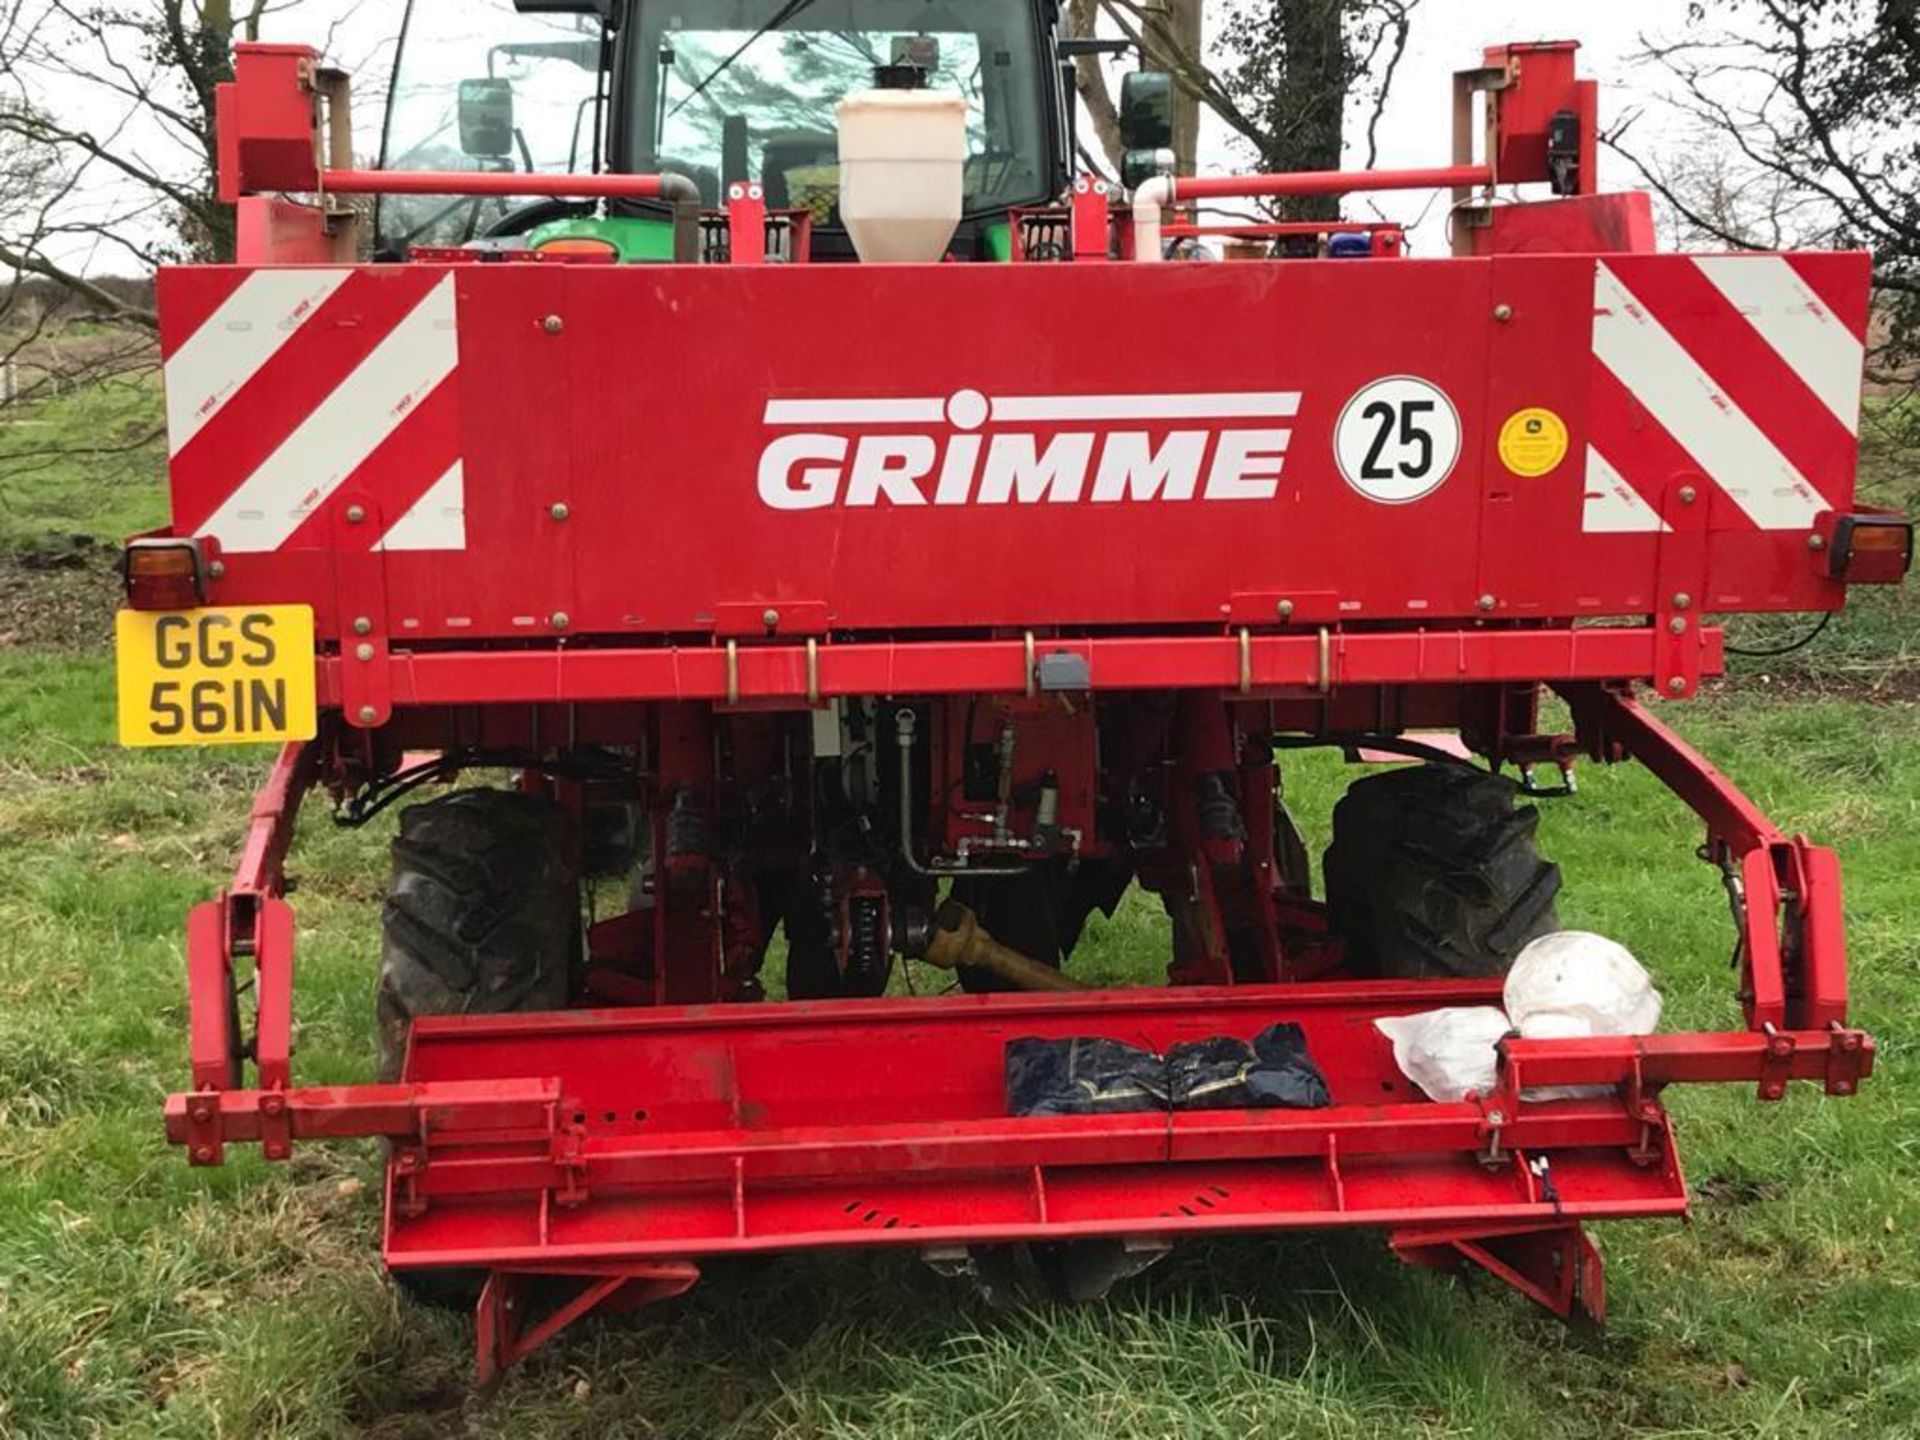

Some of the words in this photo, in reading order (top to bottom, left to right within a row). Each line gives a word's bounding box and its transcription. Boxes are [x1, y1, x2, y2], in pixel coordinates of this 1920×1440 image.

[758, 389, 1291, 509] GRIMME
[1360, 401, 1434, 479] 25
[155, 614, 276, 669] GGS
